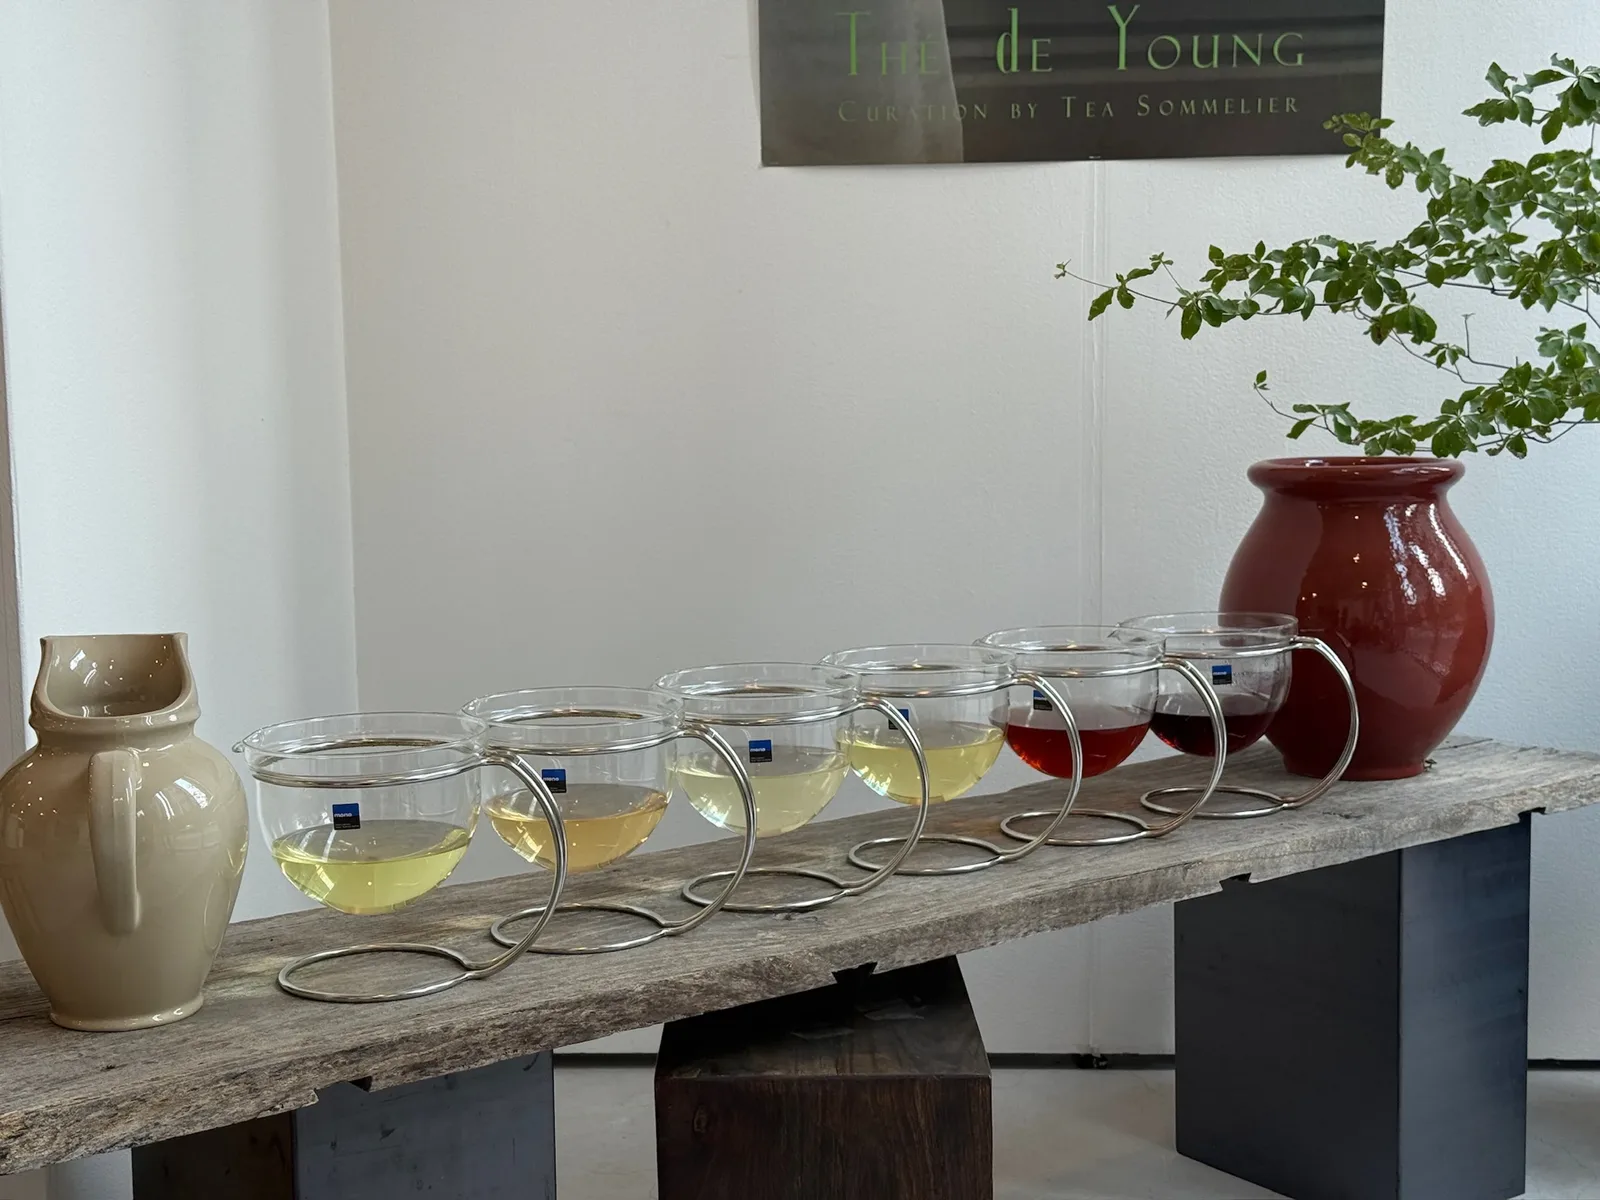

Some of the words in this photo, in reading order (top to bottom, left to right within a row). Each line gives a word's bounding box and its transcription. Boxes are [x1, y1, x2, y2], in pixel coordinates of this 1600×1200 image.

[1106, 4, 1304, 71] YOUNG
[838, 100, 988, 123] CURATION
[1010, 103, 1038, 119] BY
[1061, 96, 1114, 118] TEA
[1137, 94, 1298, 117] SOMMELIER
